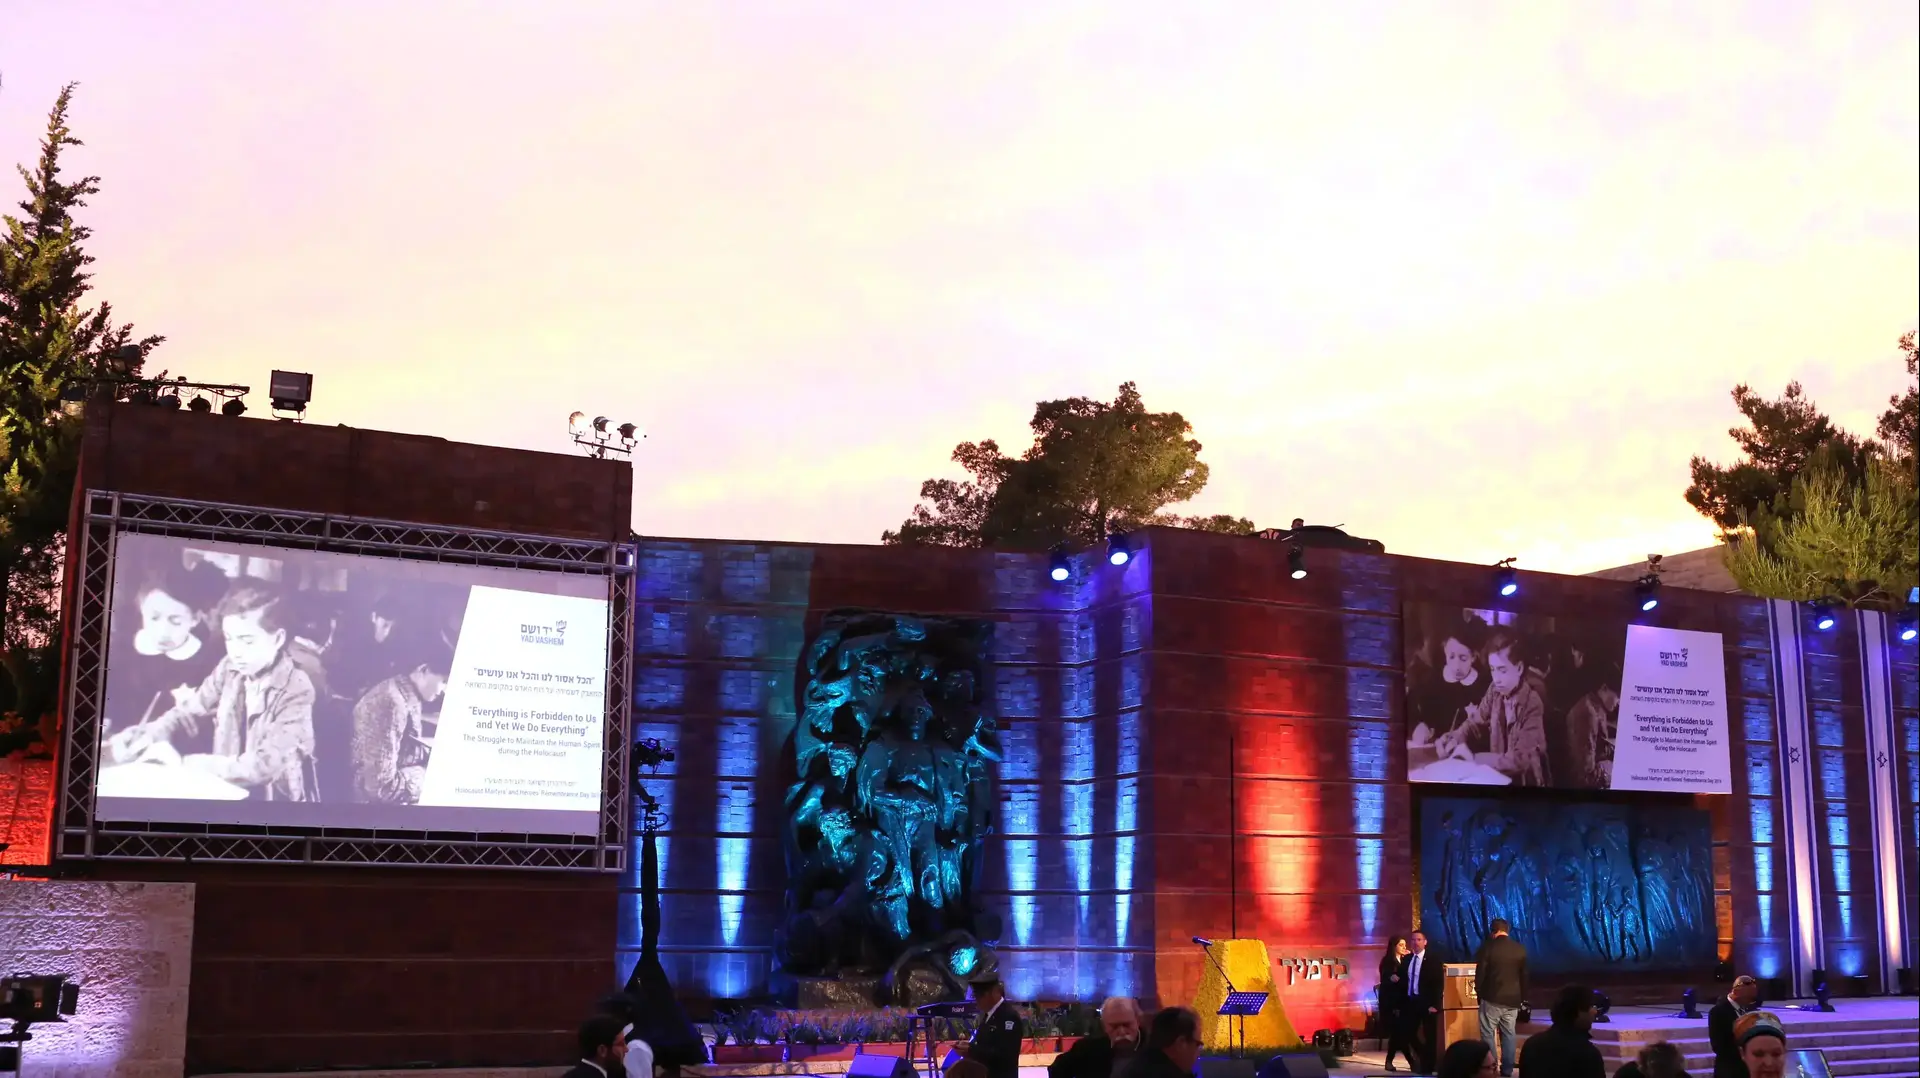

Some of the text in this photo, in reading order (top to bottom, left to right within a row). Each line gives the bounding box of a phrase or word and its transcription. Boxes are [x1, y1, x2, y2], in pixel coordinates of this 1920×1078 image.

[520, 623, 553, 635] יד ושם
[520, 634, 565, 646] YAD VASHEM
[1659, 651, 1681, 660] יד ושם
[506, 670, 518, 679] אנו
[520, 670, 540, 682] והכל
[541, 671, 553, 682] לנו
[554, 674, 575, 685] אסור
[520, 710, 529, 719] is
[530, 711, 573, 722] Forbidden
[575, 713, 584, 723] to
[585, 714, 597, 724] Us
[1666, 715, 1671, 723] is
[1672, 716, 1699, 725] Forbidden
[1699, 718, 1705, 726] to
[476, 720, 493, 730] and
[495, 720, 509, 731] Yet
[511, 721, 525, 731] We
[527, 723, 539, 732] Do
[1639, 724, 1650, 732] and
[1651, 725, 1660, 733] Yet
[463, 733, 601, 749] The Struggle to Maintain the Human Spirit
[1641, 735, 1659, 744] Struggle
[498, 747, 567, 758] during the Holocaust
[1277, 957, 1350, 986] בדמיך
